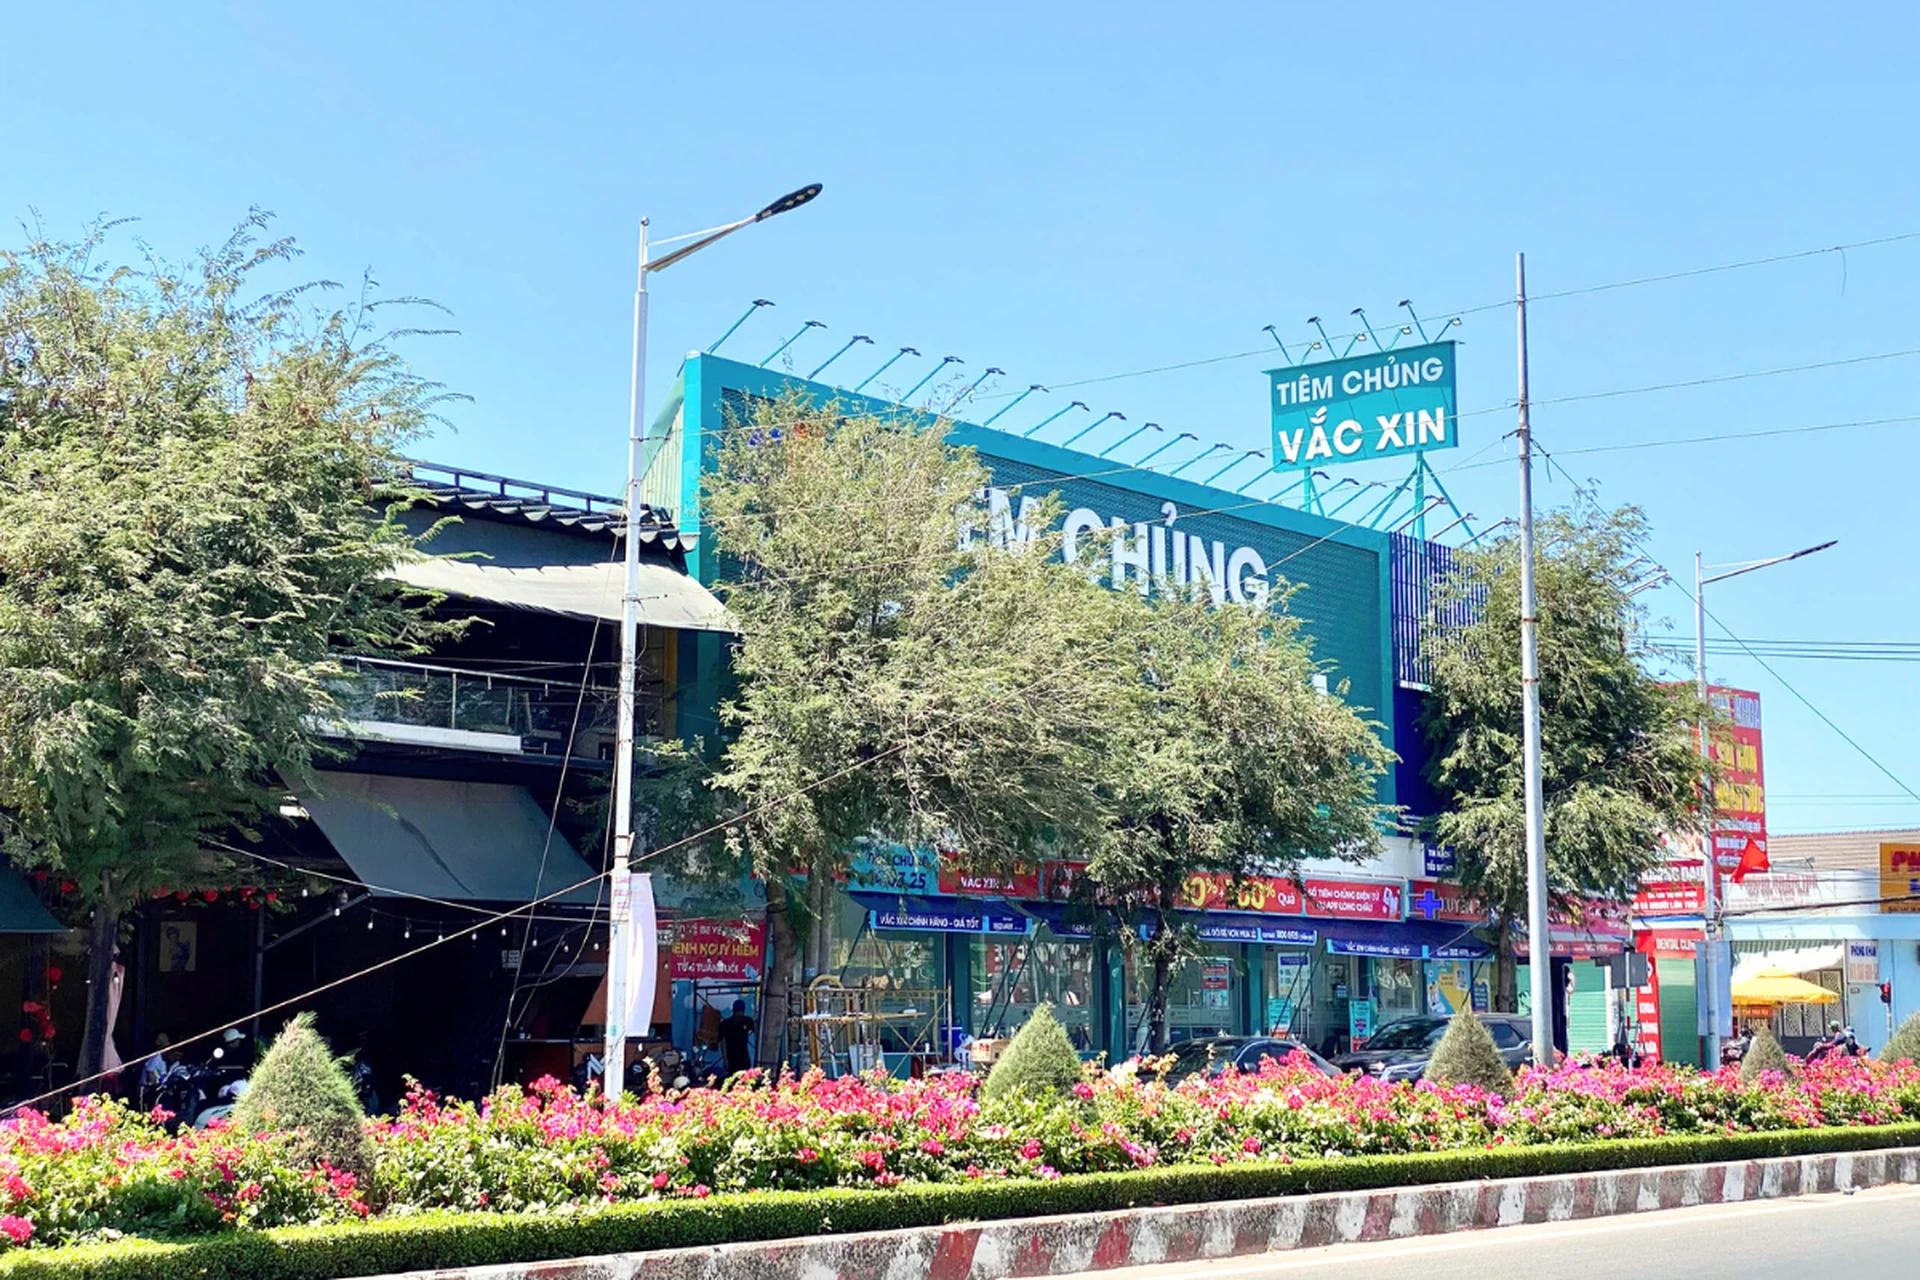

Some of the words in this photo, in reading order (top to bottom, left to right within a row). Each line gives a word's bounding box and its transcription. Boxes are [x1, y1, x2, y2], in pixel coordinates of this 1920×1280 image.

[1276, 373, 1333, 406] TIÊM
[1342, 356, 1444, 394] CHỦNG
[1278, 406, 1364, 463] VẮC
[1375, 407, 1446, 451] XIN
